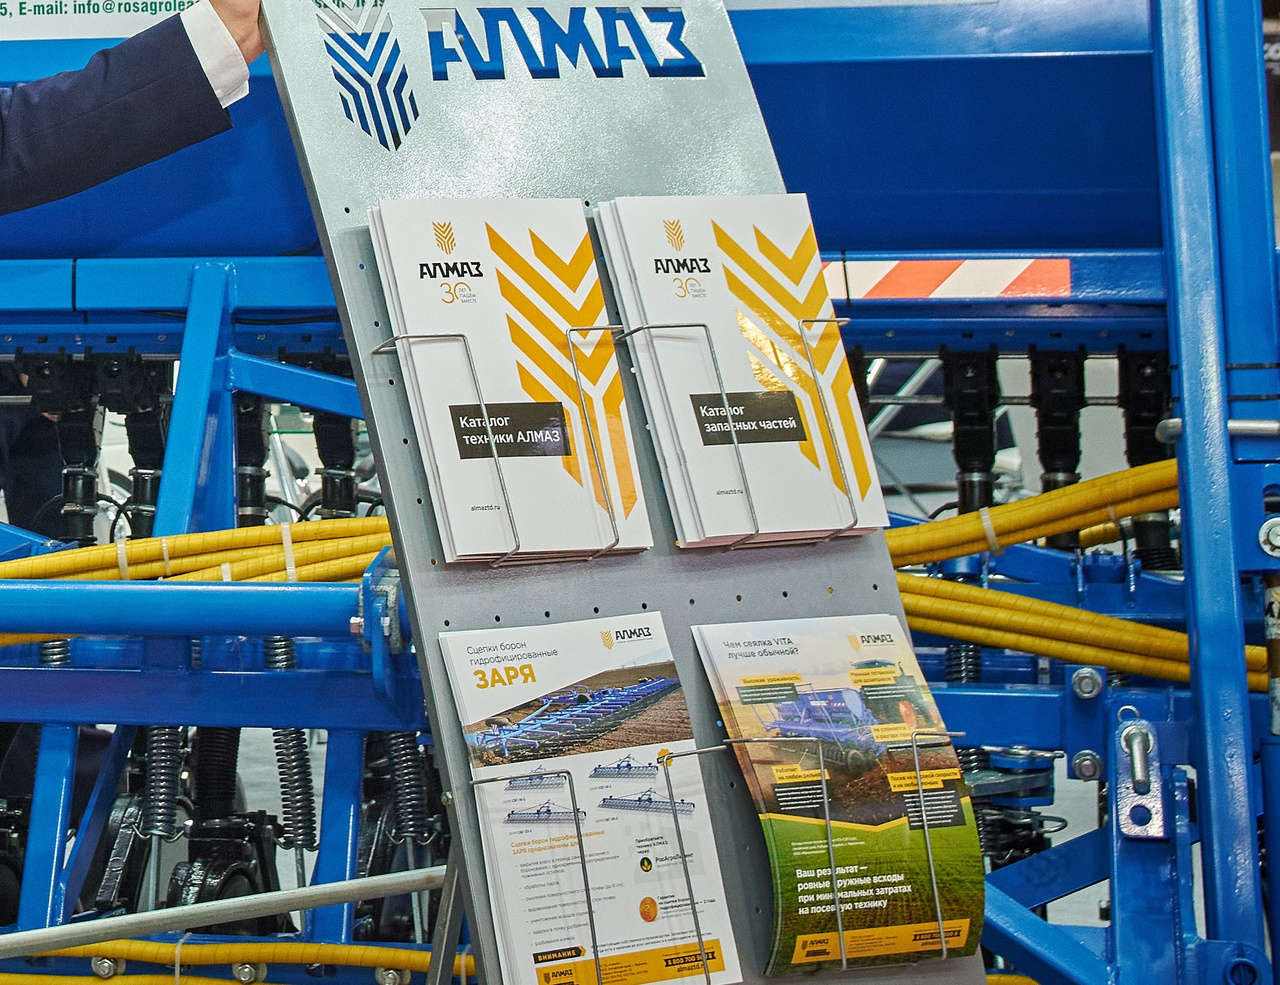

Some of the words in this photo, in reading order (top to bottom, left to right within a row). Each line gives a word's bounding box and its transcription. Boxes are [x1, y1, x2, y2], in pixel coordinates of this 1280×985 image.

[19, 0, 68, 15] E-mail:
[418, 6, 707, 81] АЛМАЗ
[419, 261, 484, 279] АЛМАЗ
[654, 258, 711, 273] АЛМАЗ
[459, 416, 510, 428] Каталог
[704, 420, 758, 432] запасных
[759, 417, 797, 430] частей
[463, 433, 513, 445] техники
[517, 430, 561, 443] АЛМАЗ
[615, 627, 652, 641] АЛМАЗ
[860, 633, 894, 644] АЛМАЗ
[467, 643, 498, 655] Сцепки
[500, 641, 527, 653] борон
[723, 640, 741, 649] Чем
[743, 639, 772, 648] сеялка
[773, 637, 794, 646] VITA
[470, 649, 558, 666] гидрофицированные
[728, 650, 756, 659] лучше
[758, 647, 799, 657] обычной?
[473, 664, 537, 690] ЗАРЯ
[796, 868, 815, 878] Ваш
[817, 865, 858, 877] резльтат
[797, 880, 830, 892] ровные
[835, 876, 871, 888] ружные
[873, 873, 904, 884] всходы
[798, 894, 814, 904] при
[816, 888, 874, 901] минмальных
[875, 885, 912, 896] затратах
[798, 906, 809, 915] на
[811, 902, 853, 914] посевую
[854, 899, 888, 909] технику
[677, 962, 705, 973] almaztd.r
